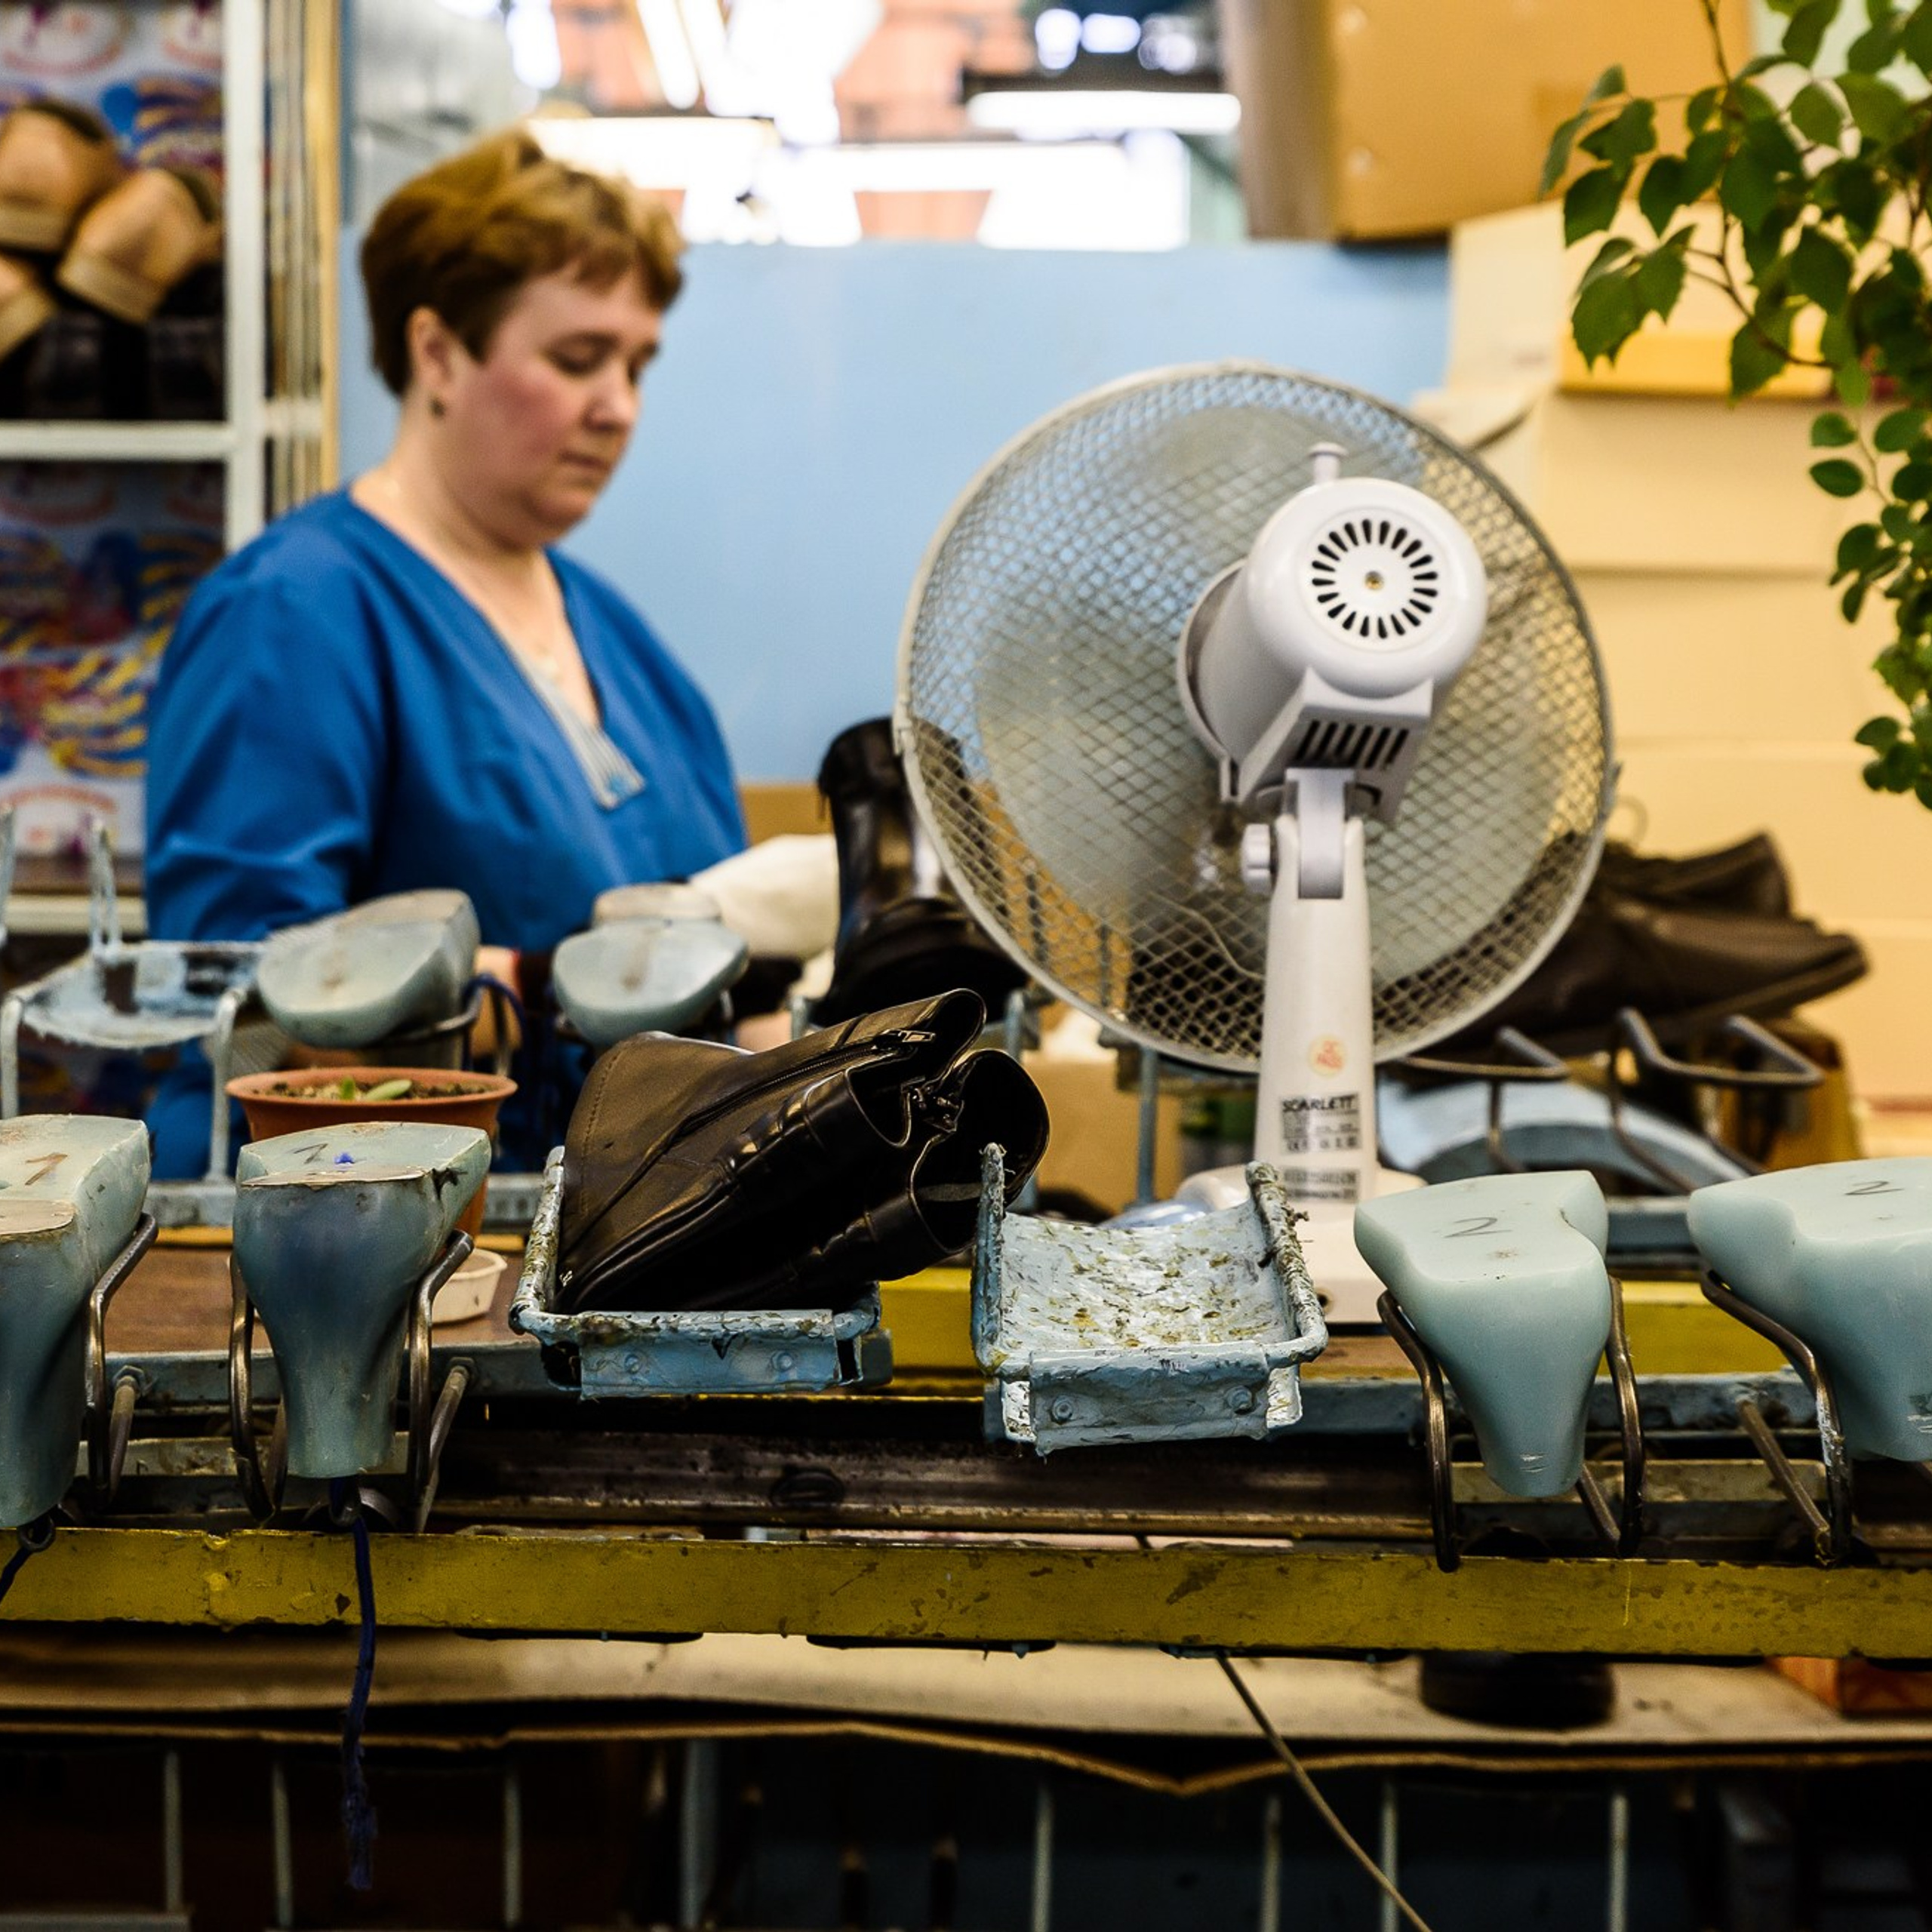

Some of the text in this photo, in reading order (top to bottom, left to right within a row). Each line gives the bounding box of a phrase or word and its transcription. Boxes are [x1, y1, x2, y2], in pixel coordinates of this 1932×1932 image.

[1283, 1095, 1355, 1112] SCARLETT
[1844, 1180, 1904, 1196] 2
[1443, 1216, 1512, 1238] 2
